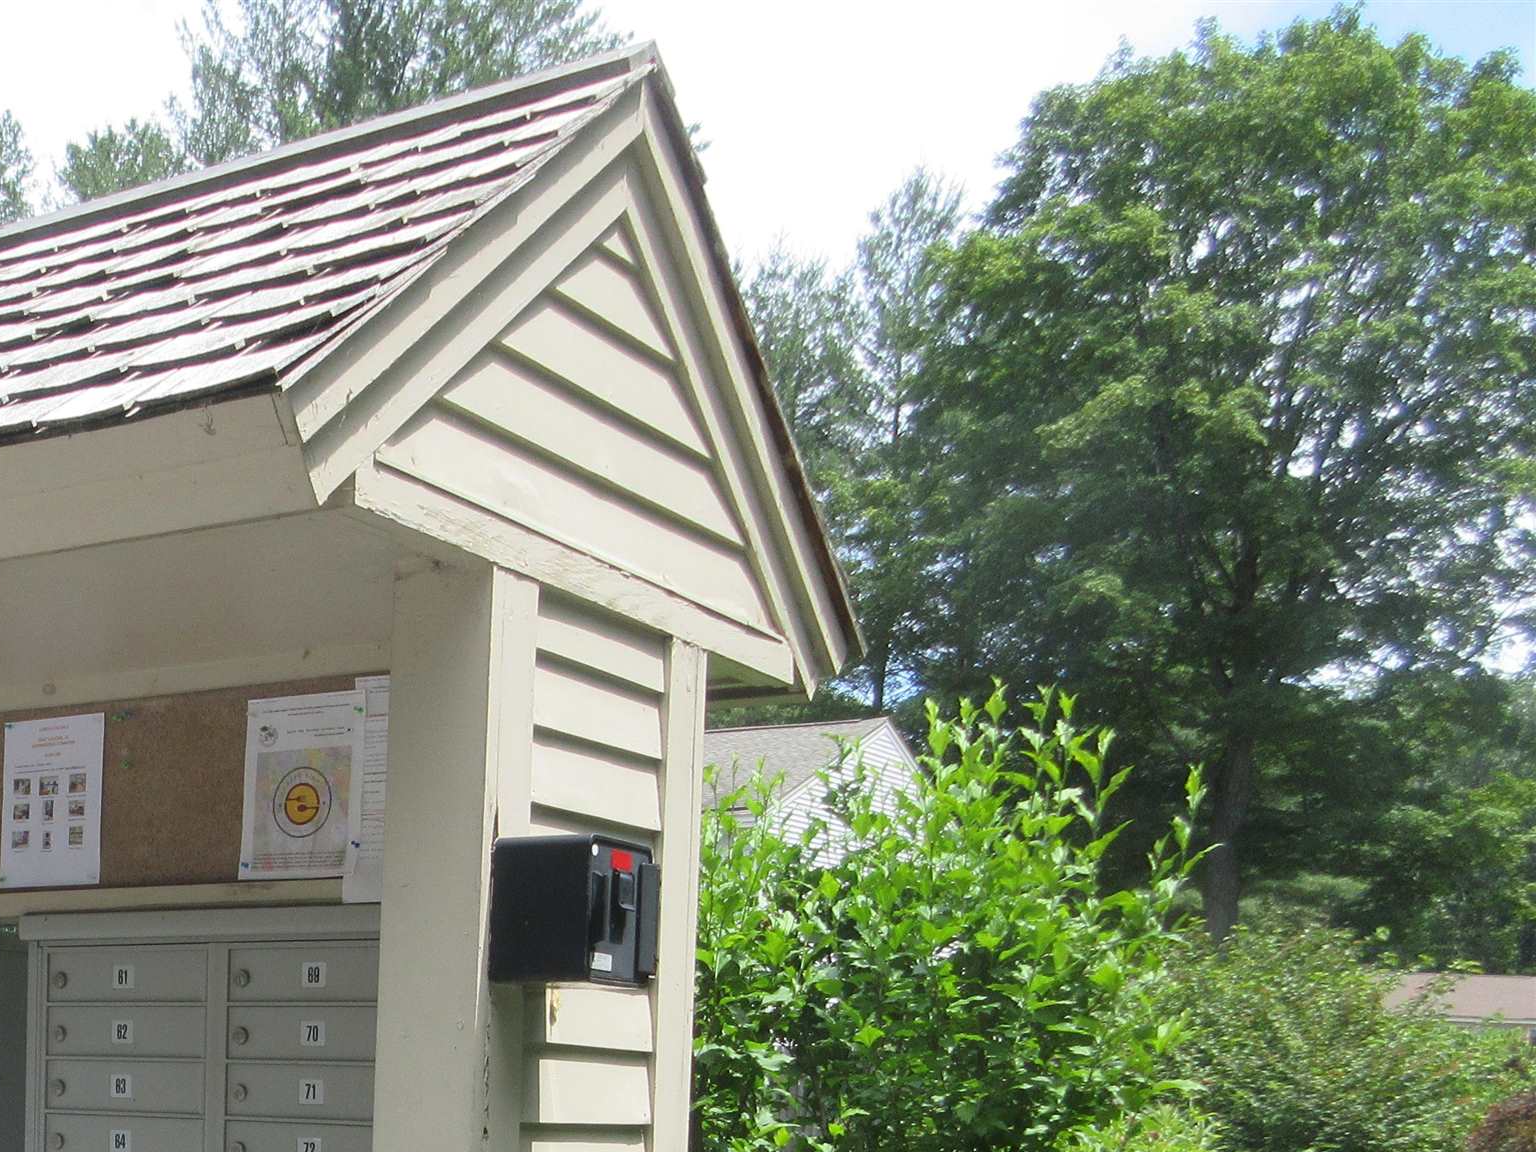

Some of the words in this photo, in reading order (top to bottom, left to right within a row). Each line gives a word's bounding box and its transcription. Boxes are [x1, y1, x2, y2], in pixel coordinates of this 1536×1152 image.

[118, 969, 128, 985] 61
[307, 966, 320, 984] 69
[116, 1023, 128, 1040] 62
[306, 1025, 319, 1042] 70
[115, 1078, 126, 1094] 63
[305, 1083, 316, 1100] 71
[114, 1133, 126, 1149] 64
